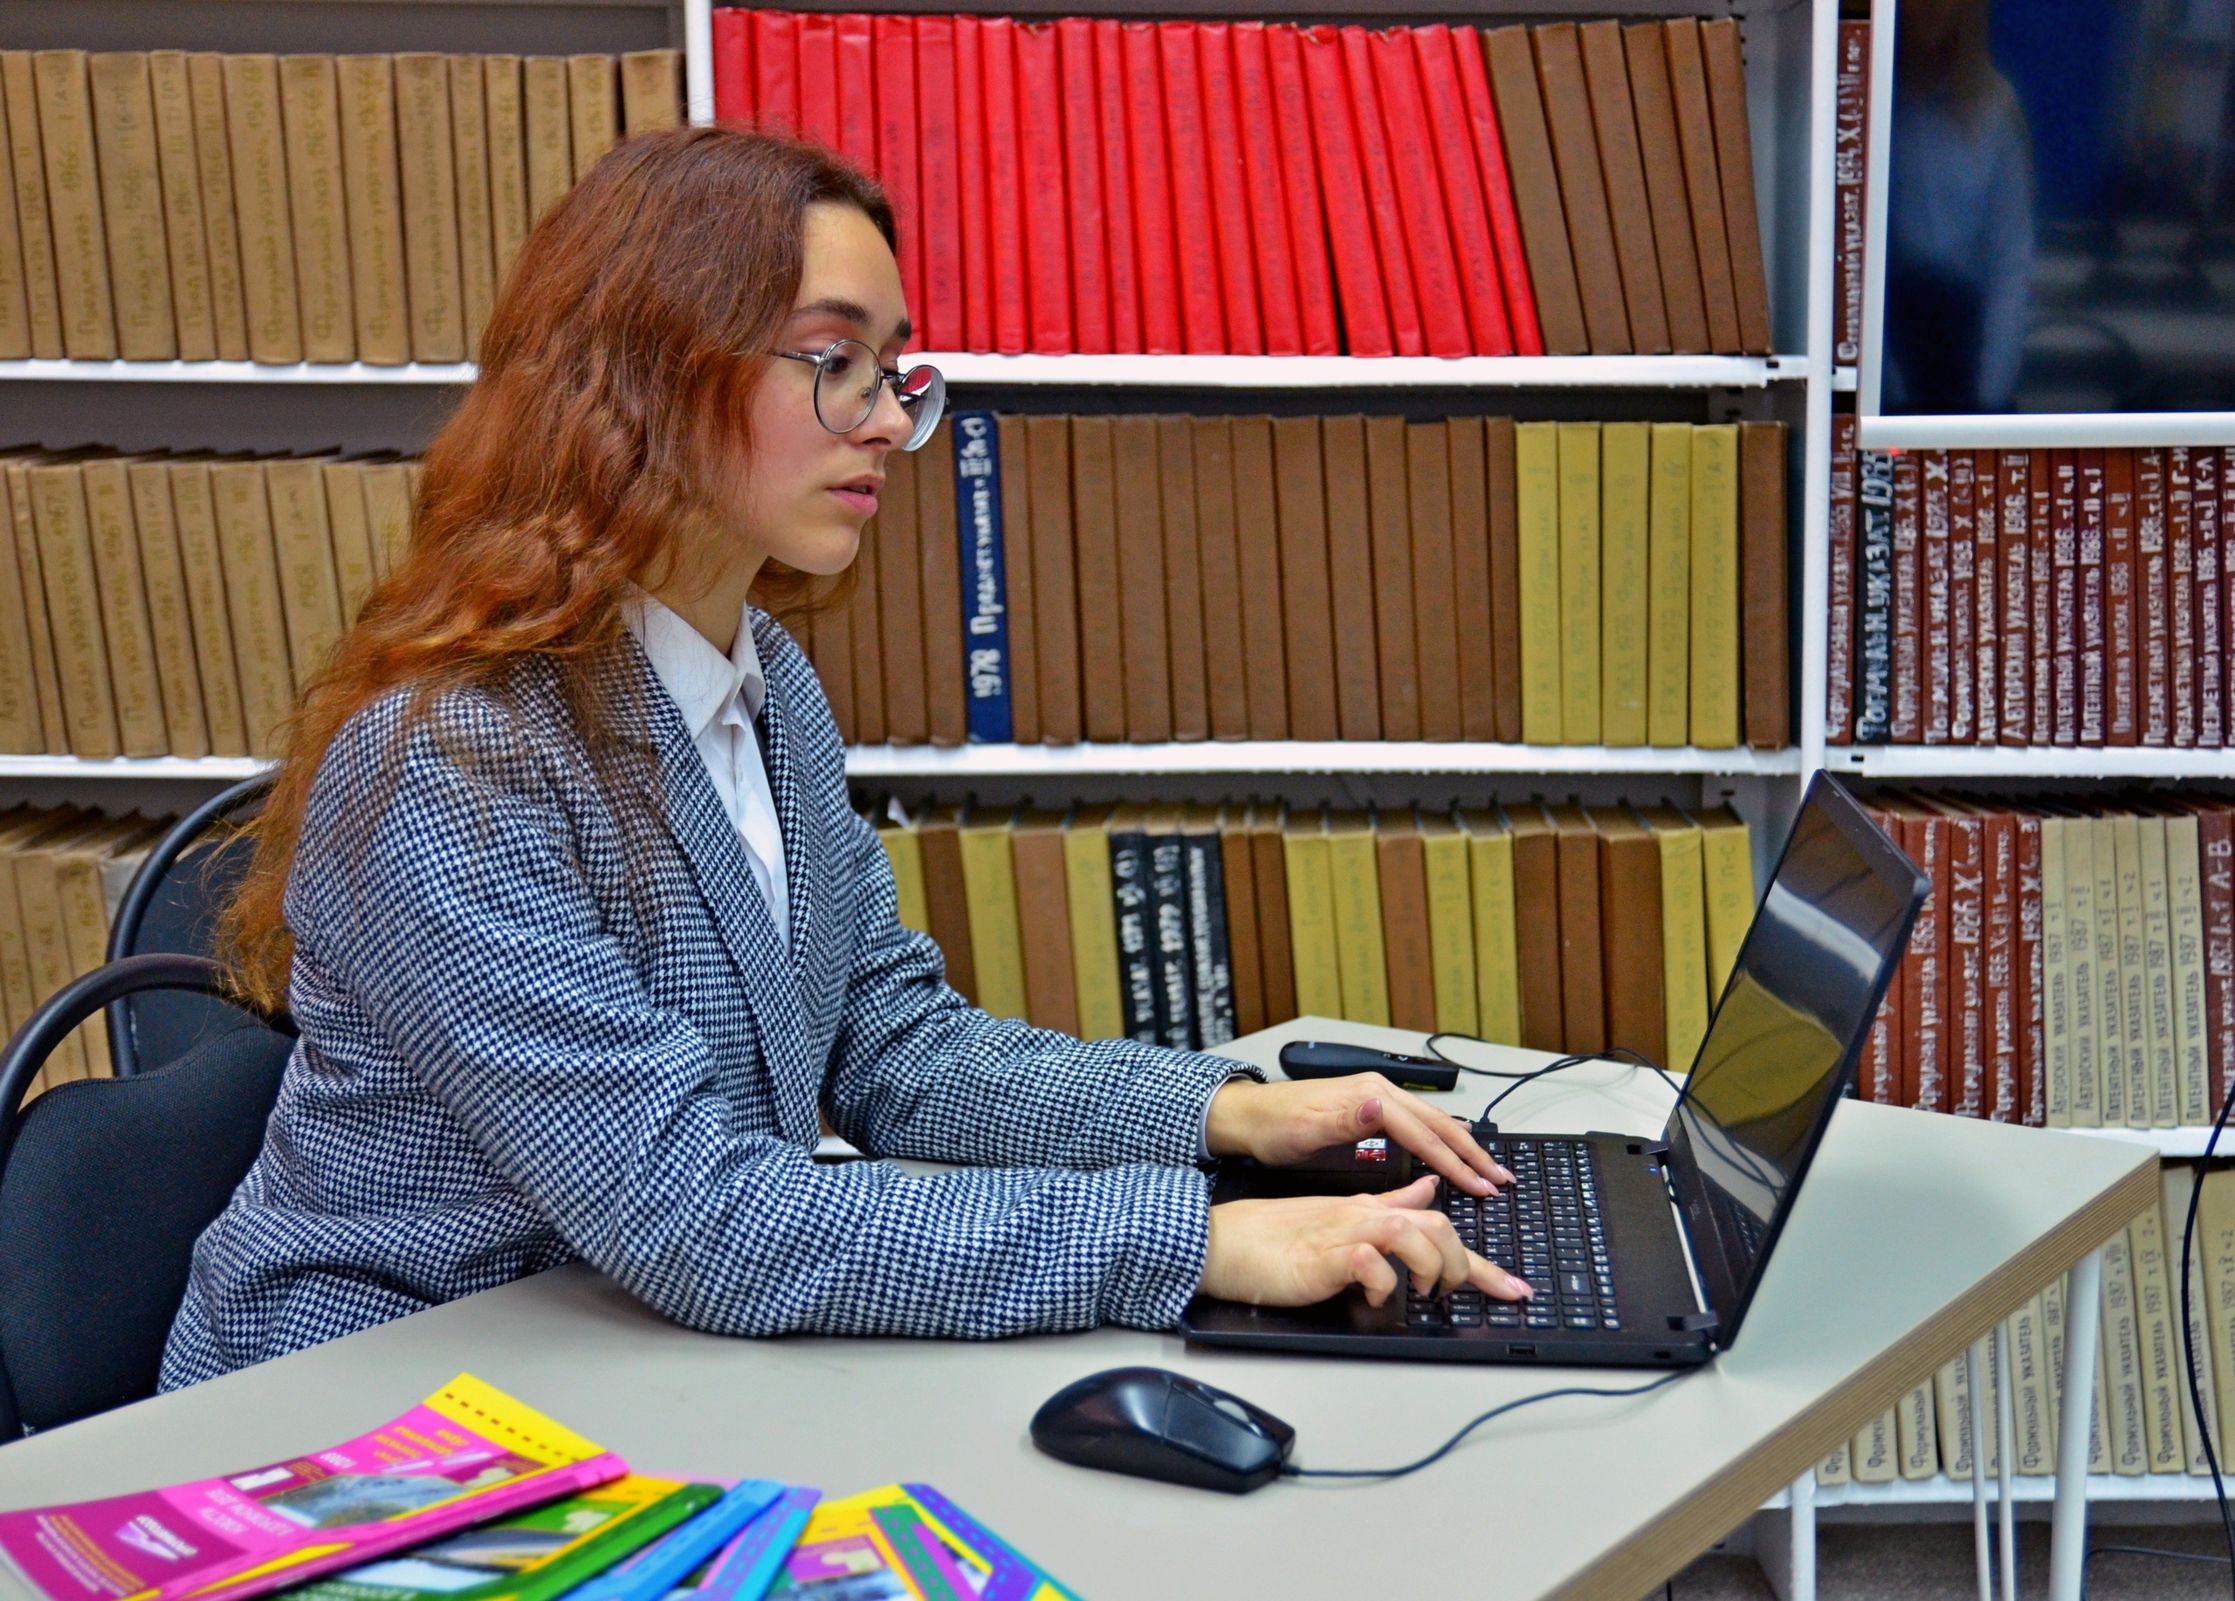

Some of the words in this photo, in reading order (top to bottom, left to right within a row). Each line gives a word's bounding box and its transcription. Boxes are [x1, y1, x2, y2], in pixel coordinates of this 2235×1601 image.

[58, 142, 81, 192] 1966
[970, 649, 1003, 697] 1978
[2123, 934, 2140, 967] 1987
[2148, 940, 2165, 969] 1987
[2179, 934, 2197, 966] 1987
[2108, 1280, 2127, 1309] 1987
[2144, 1285, 2161, 1313] 1987
